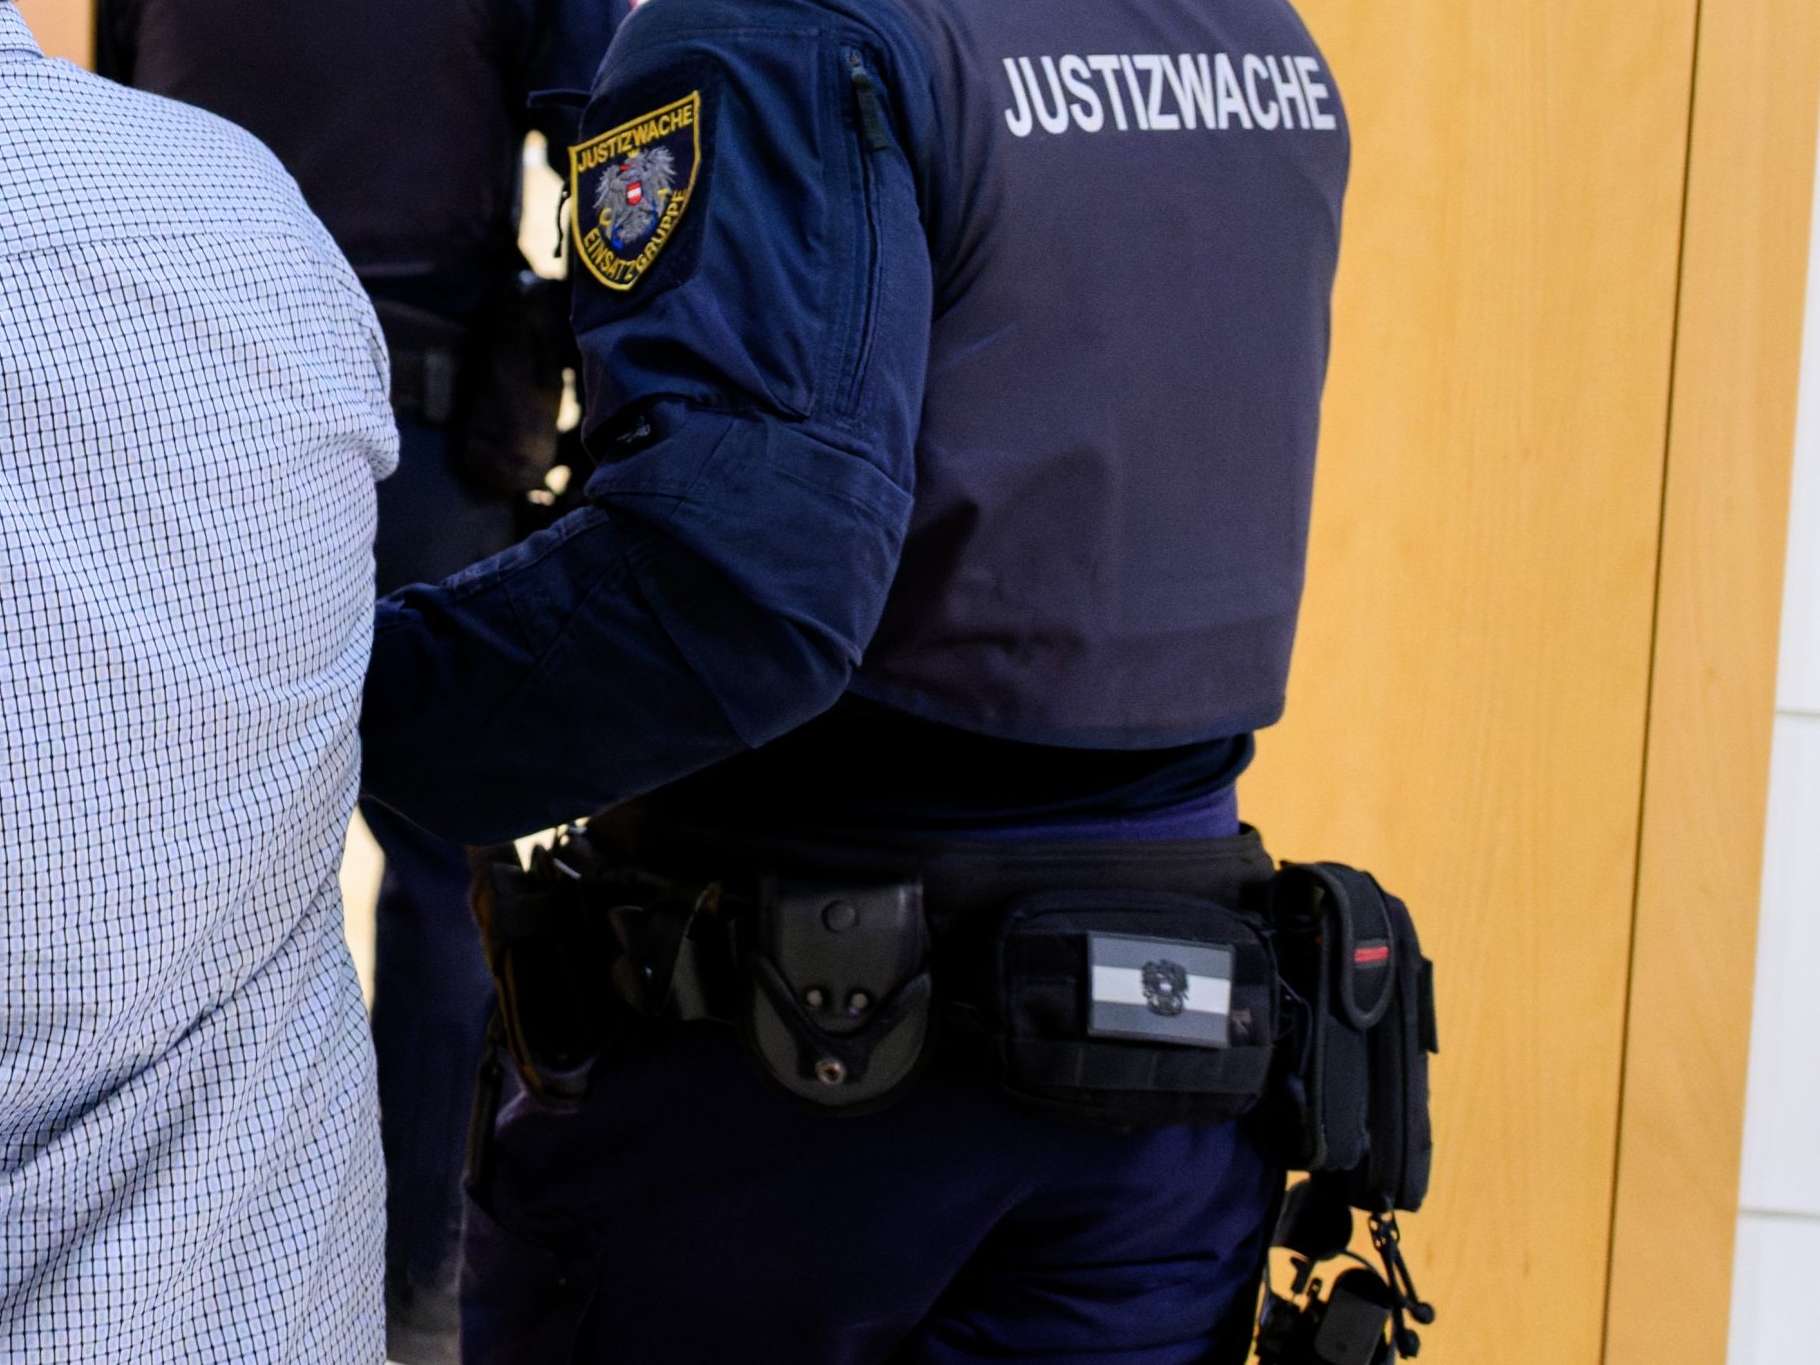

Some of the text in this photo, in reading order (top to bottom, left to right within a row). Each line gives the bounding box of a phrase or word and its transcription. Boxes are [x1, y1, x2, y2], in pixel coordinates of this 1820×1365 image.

[1002, 53, 1337, 137] JUSTIZWACHE
[578, 104, 694, 172] JUSTIZWACHE
[582, 188, 688, 281] EINSATZGRUPPE
